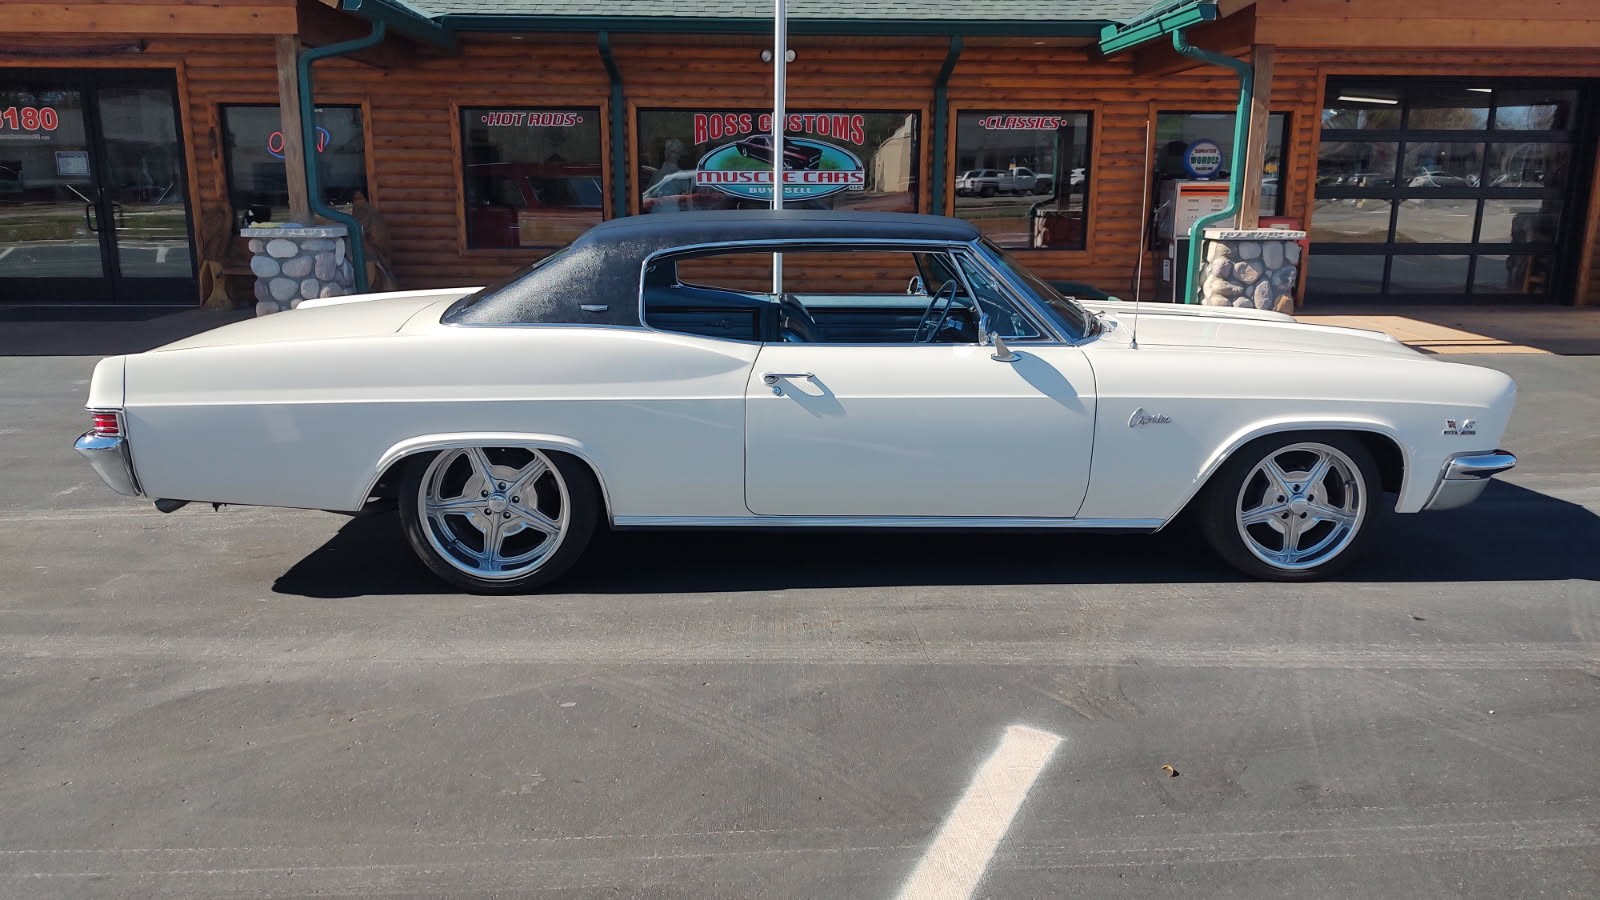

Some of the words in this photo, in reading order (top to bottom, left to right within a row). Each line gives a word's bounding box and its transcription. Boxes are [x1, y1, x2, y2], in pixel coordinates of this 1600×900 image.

[0, 107, 59, 131] 180
[487, 112, 526, 127] HOT
[527, 112, 577, 127] RODS
[985, 116, 1062, 130] CLASSICS
[694, 113, 752, 145] ROSS
[758, 114, 865, 146] CSTOMS
[803, 172, 864, 183] CARS
